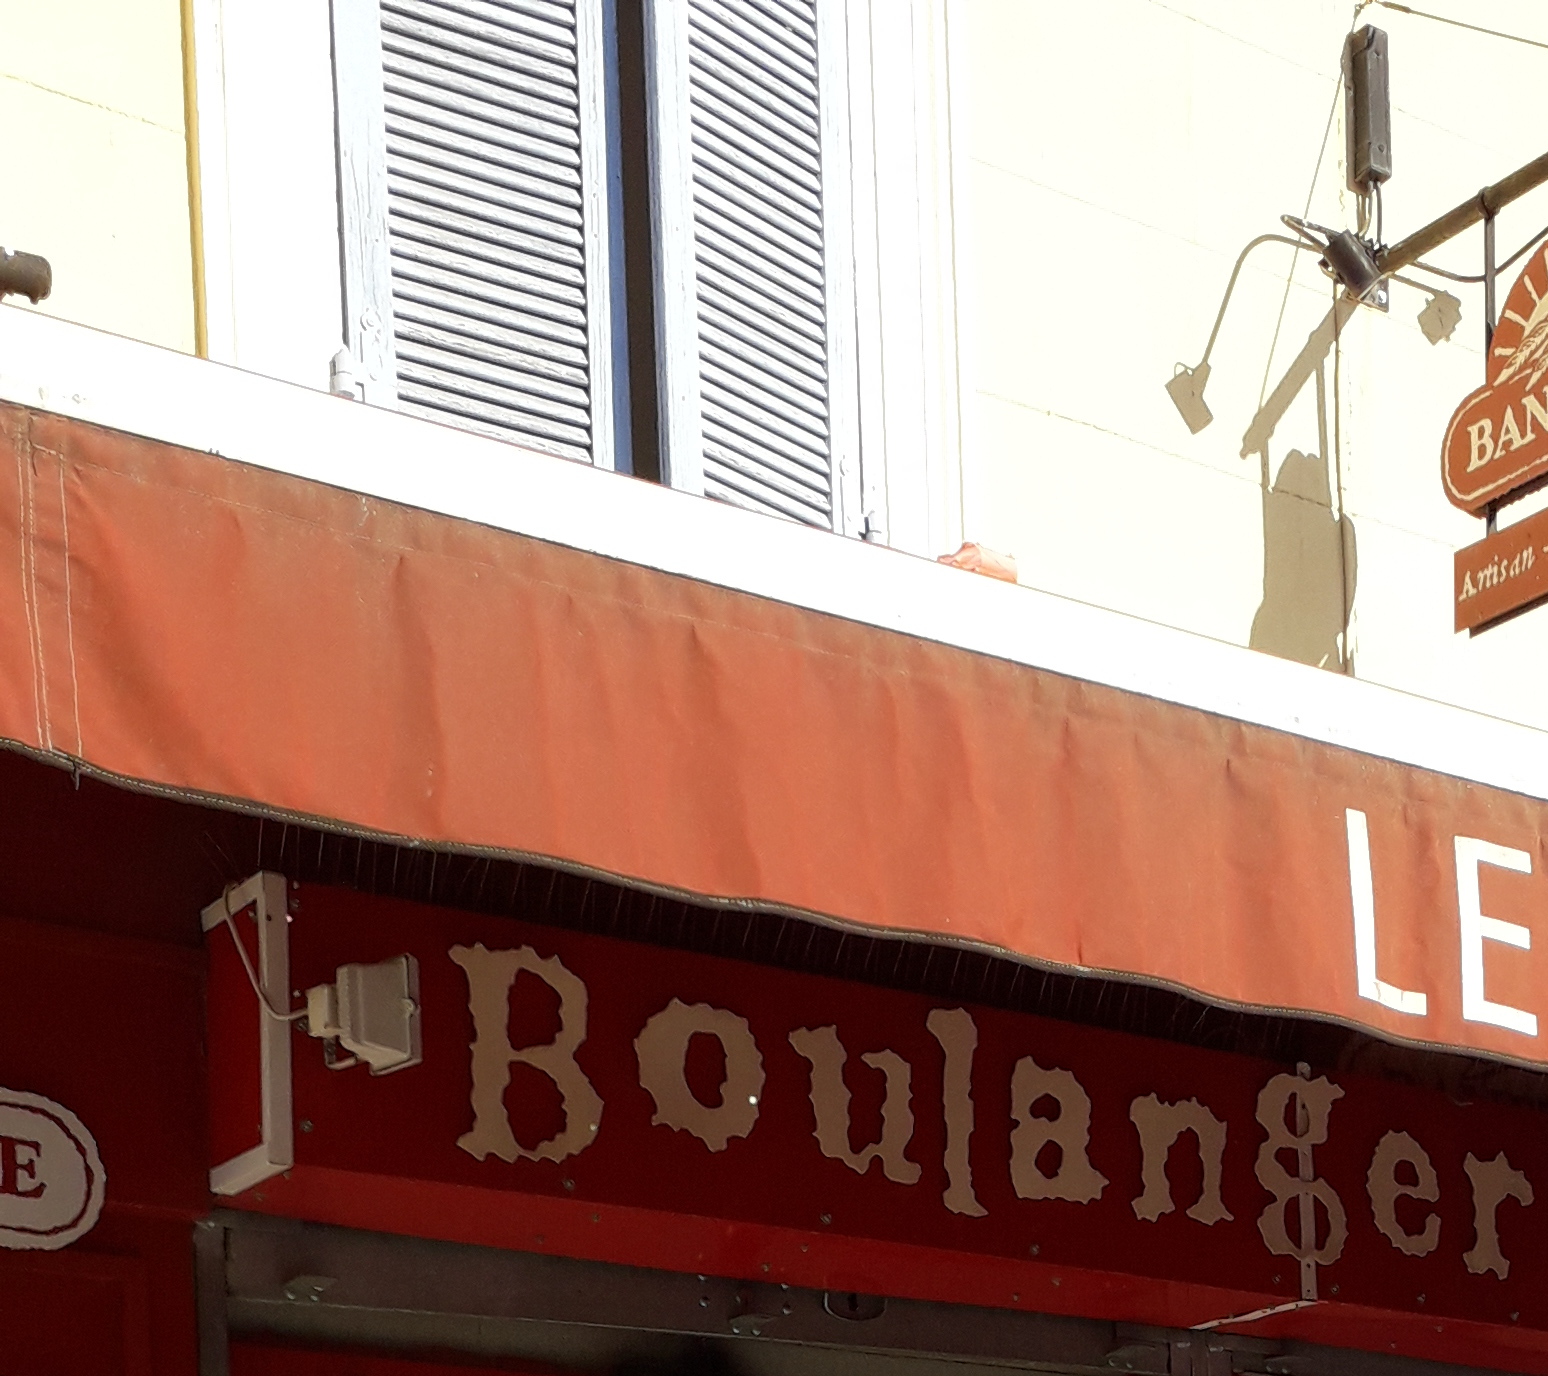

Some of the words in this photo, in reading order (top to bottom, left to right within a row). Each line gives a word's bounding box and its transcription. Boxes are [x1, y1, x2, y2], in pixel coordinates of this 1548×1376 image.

[1458, 543, 1535, 601] Artisan
[1345, 807, 1537, 1037] LE
[448, 942, 1534, 1280] Boulanger
